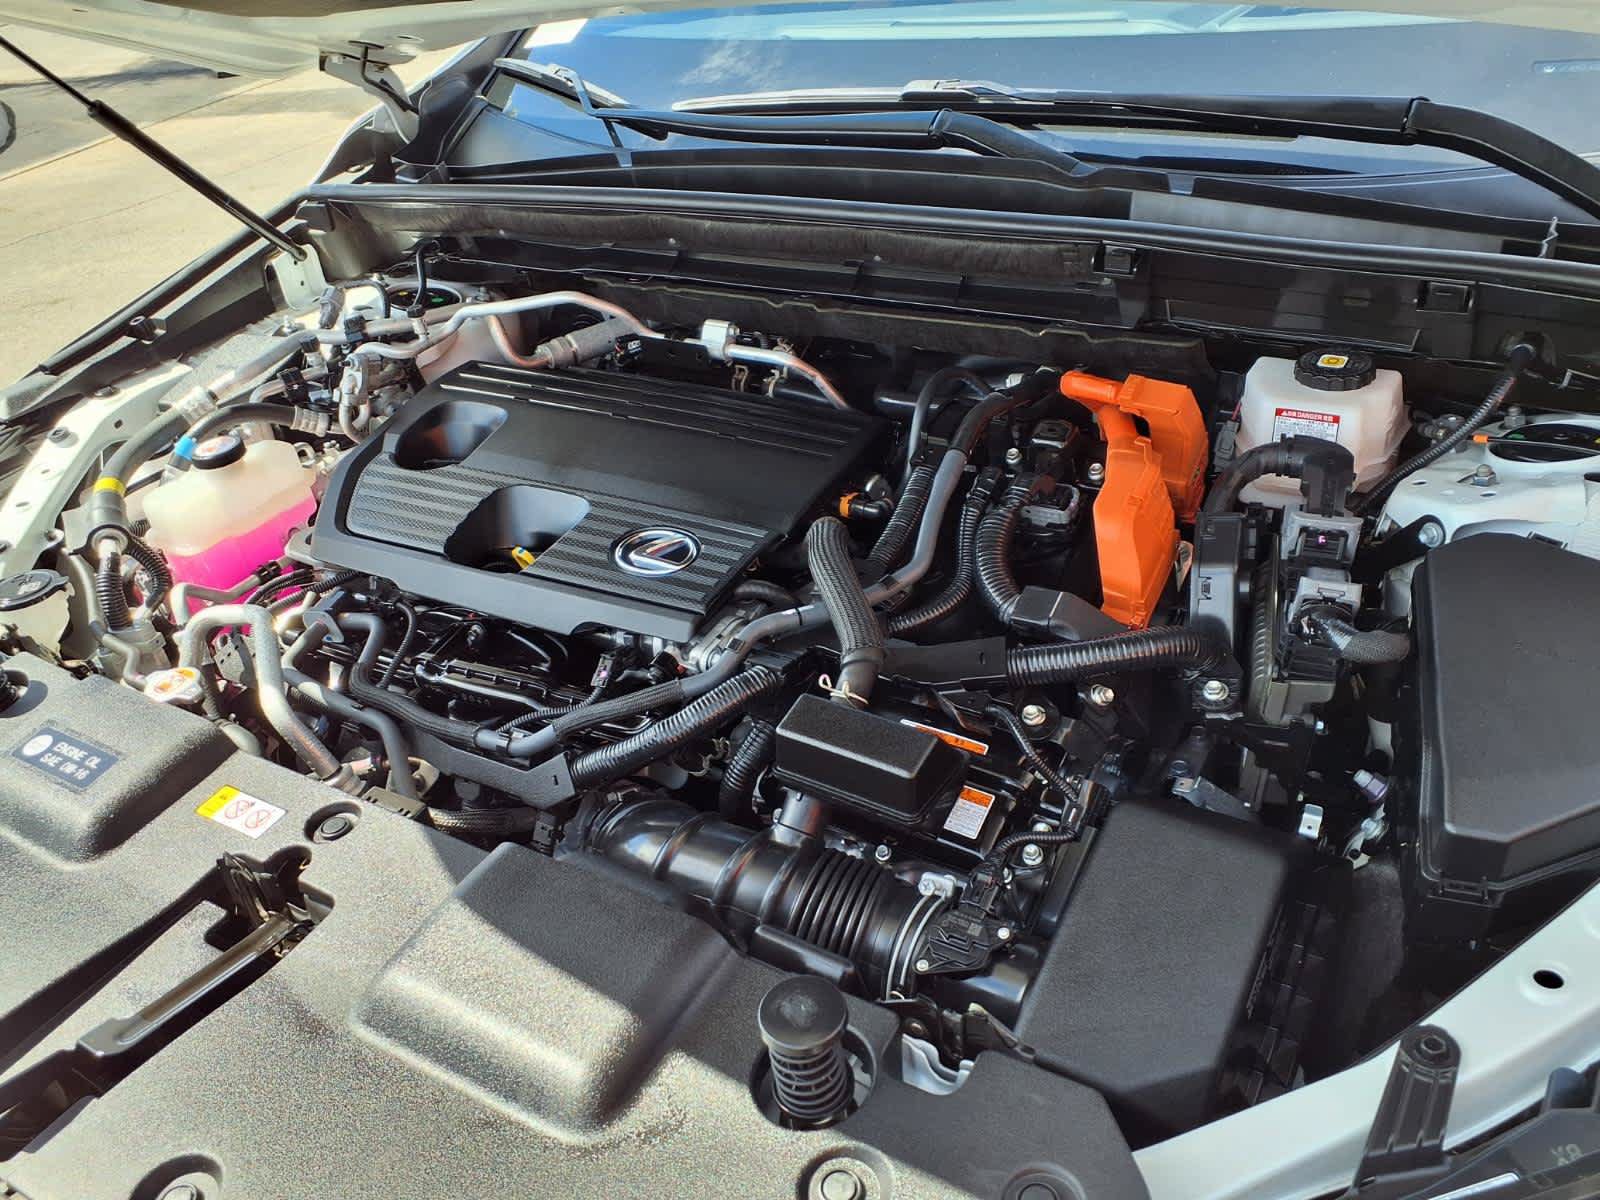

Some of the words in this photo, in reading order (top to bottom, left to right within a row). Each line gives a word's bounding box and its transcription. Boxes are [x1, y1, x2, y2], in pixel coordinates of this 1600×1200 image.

[40, 752, 63, 768] SAE
[53, 741, 88, 761] ENGINE
[85, 756, 101, 769] OIL
